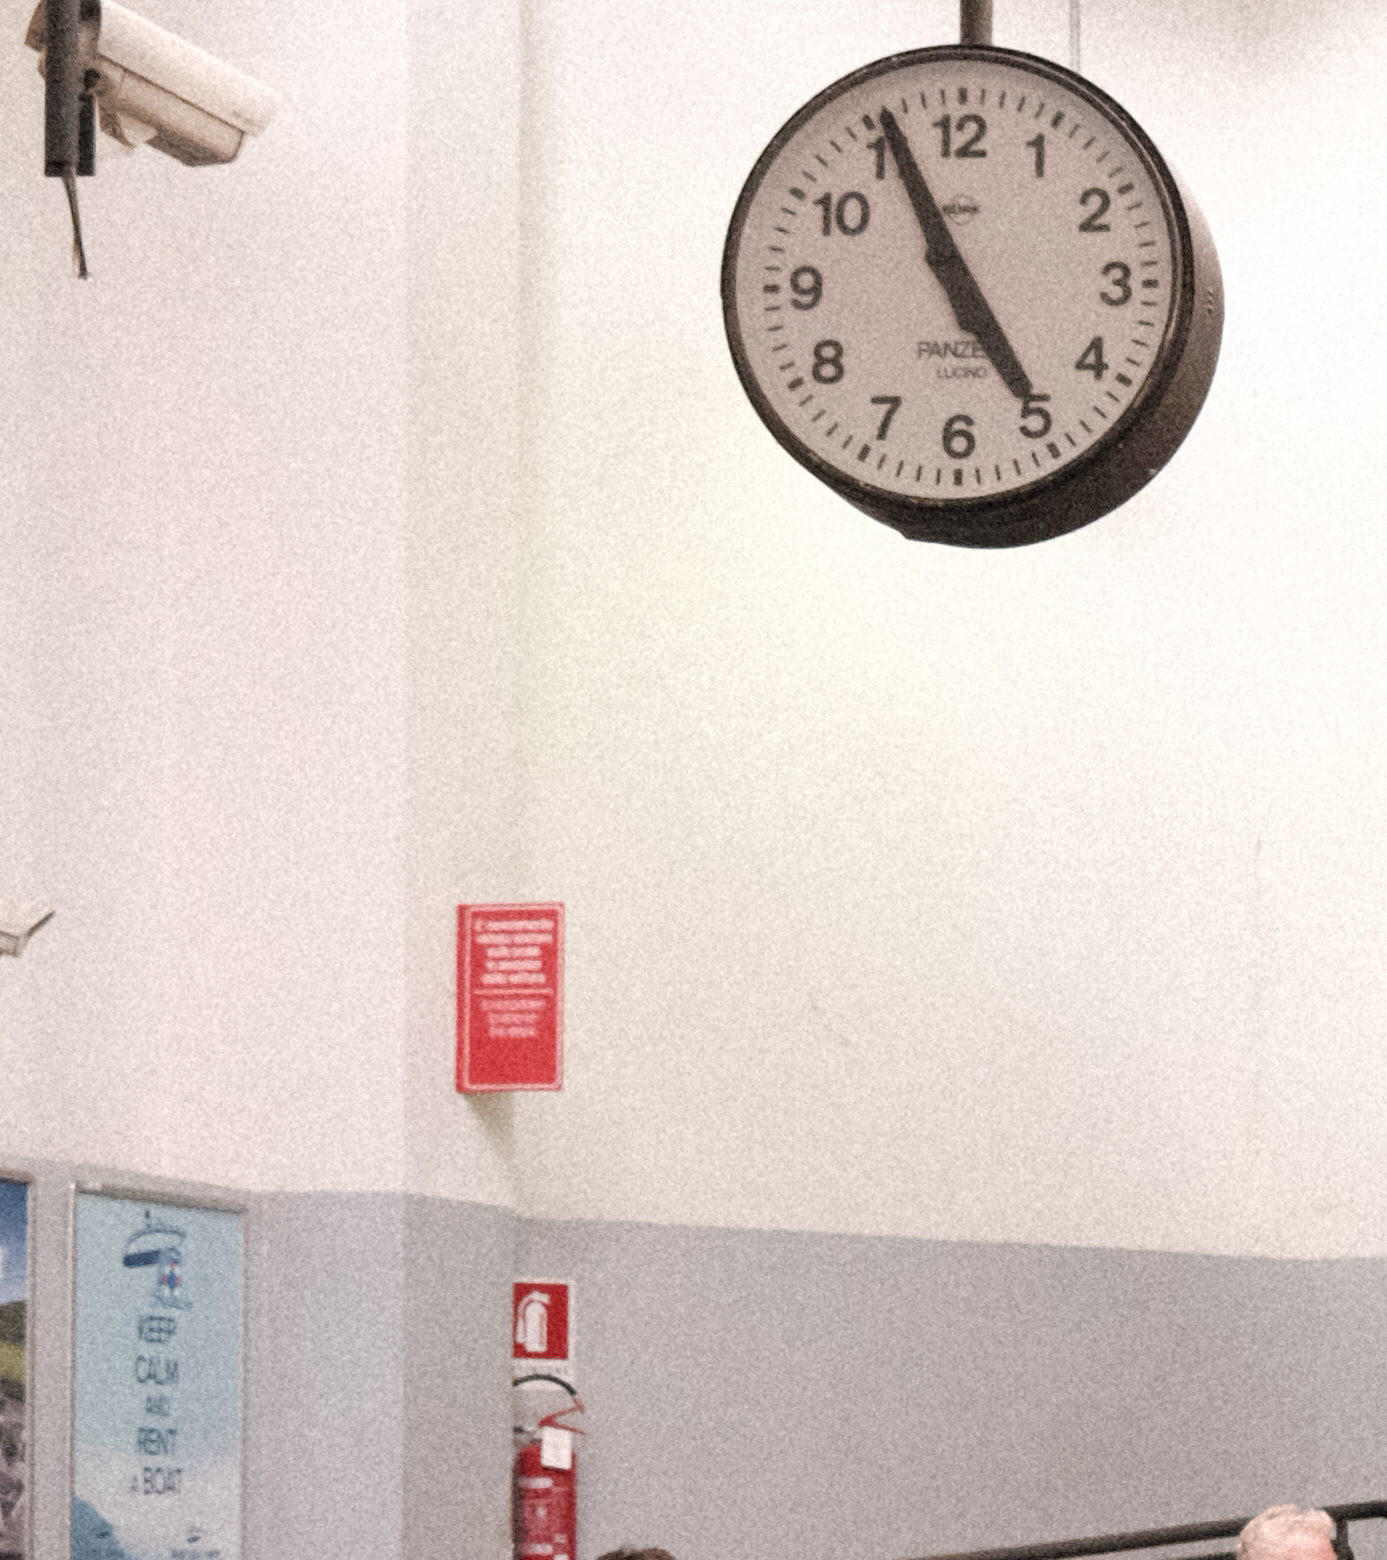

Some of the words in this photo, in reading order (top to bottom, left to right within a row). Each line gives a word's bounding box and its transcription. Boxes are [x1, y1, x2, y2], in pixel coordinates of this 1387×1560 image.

[933, 114, 987, 158] 12
[1026, 134, 1045, 177] 1
[814, 191, 869, 236] 10
[1078, 188, 1111, 232] 2
[790, 266, 823, 310] 9
[1100, 262, 1132, 306] 3
[812, 340, 844, 384] 8
[917, 341, 987, 359] PANZE
[1076, 336, 1108, 380] 4
[871, 396, 902, 441] 7
[943, 414, 975, 459] 6
[1019, 393, 1052, 439] 5
[134, 1356, 178, 1385] CALM
[136, 1428, 177, 1455] RENT
[143, 1468, 183, 1495] BOAT
